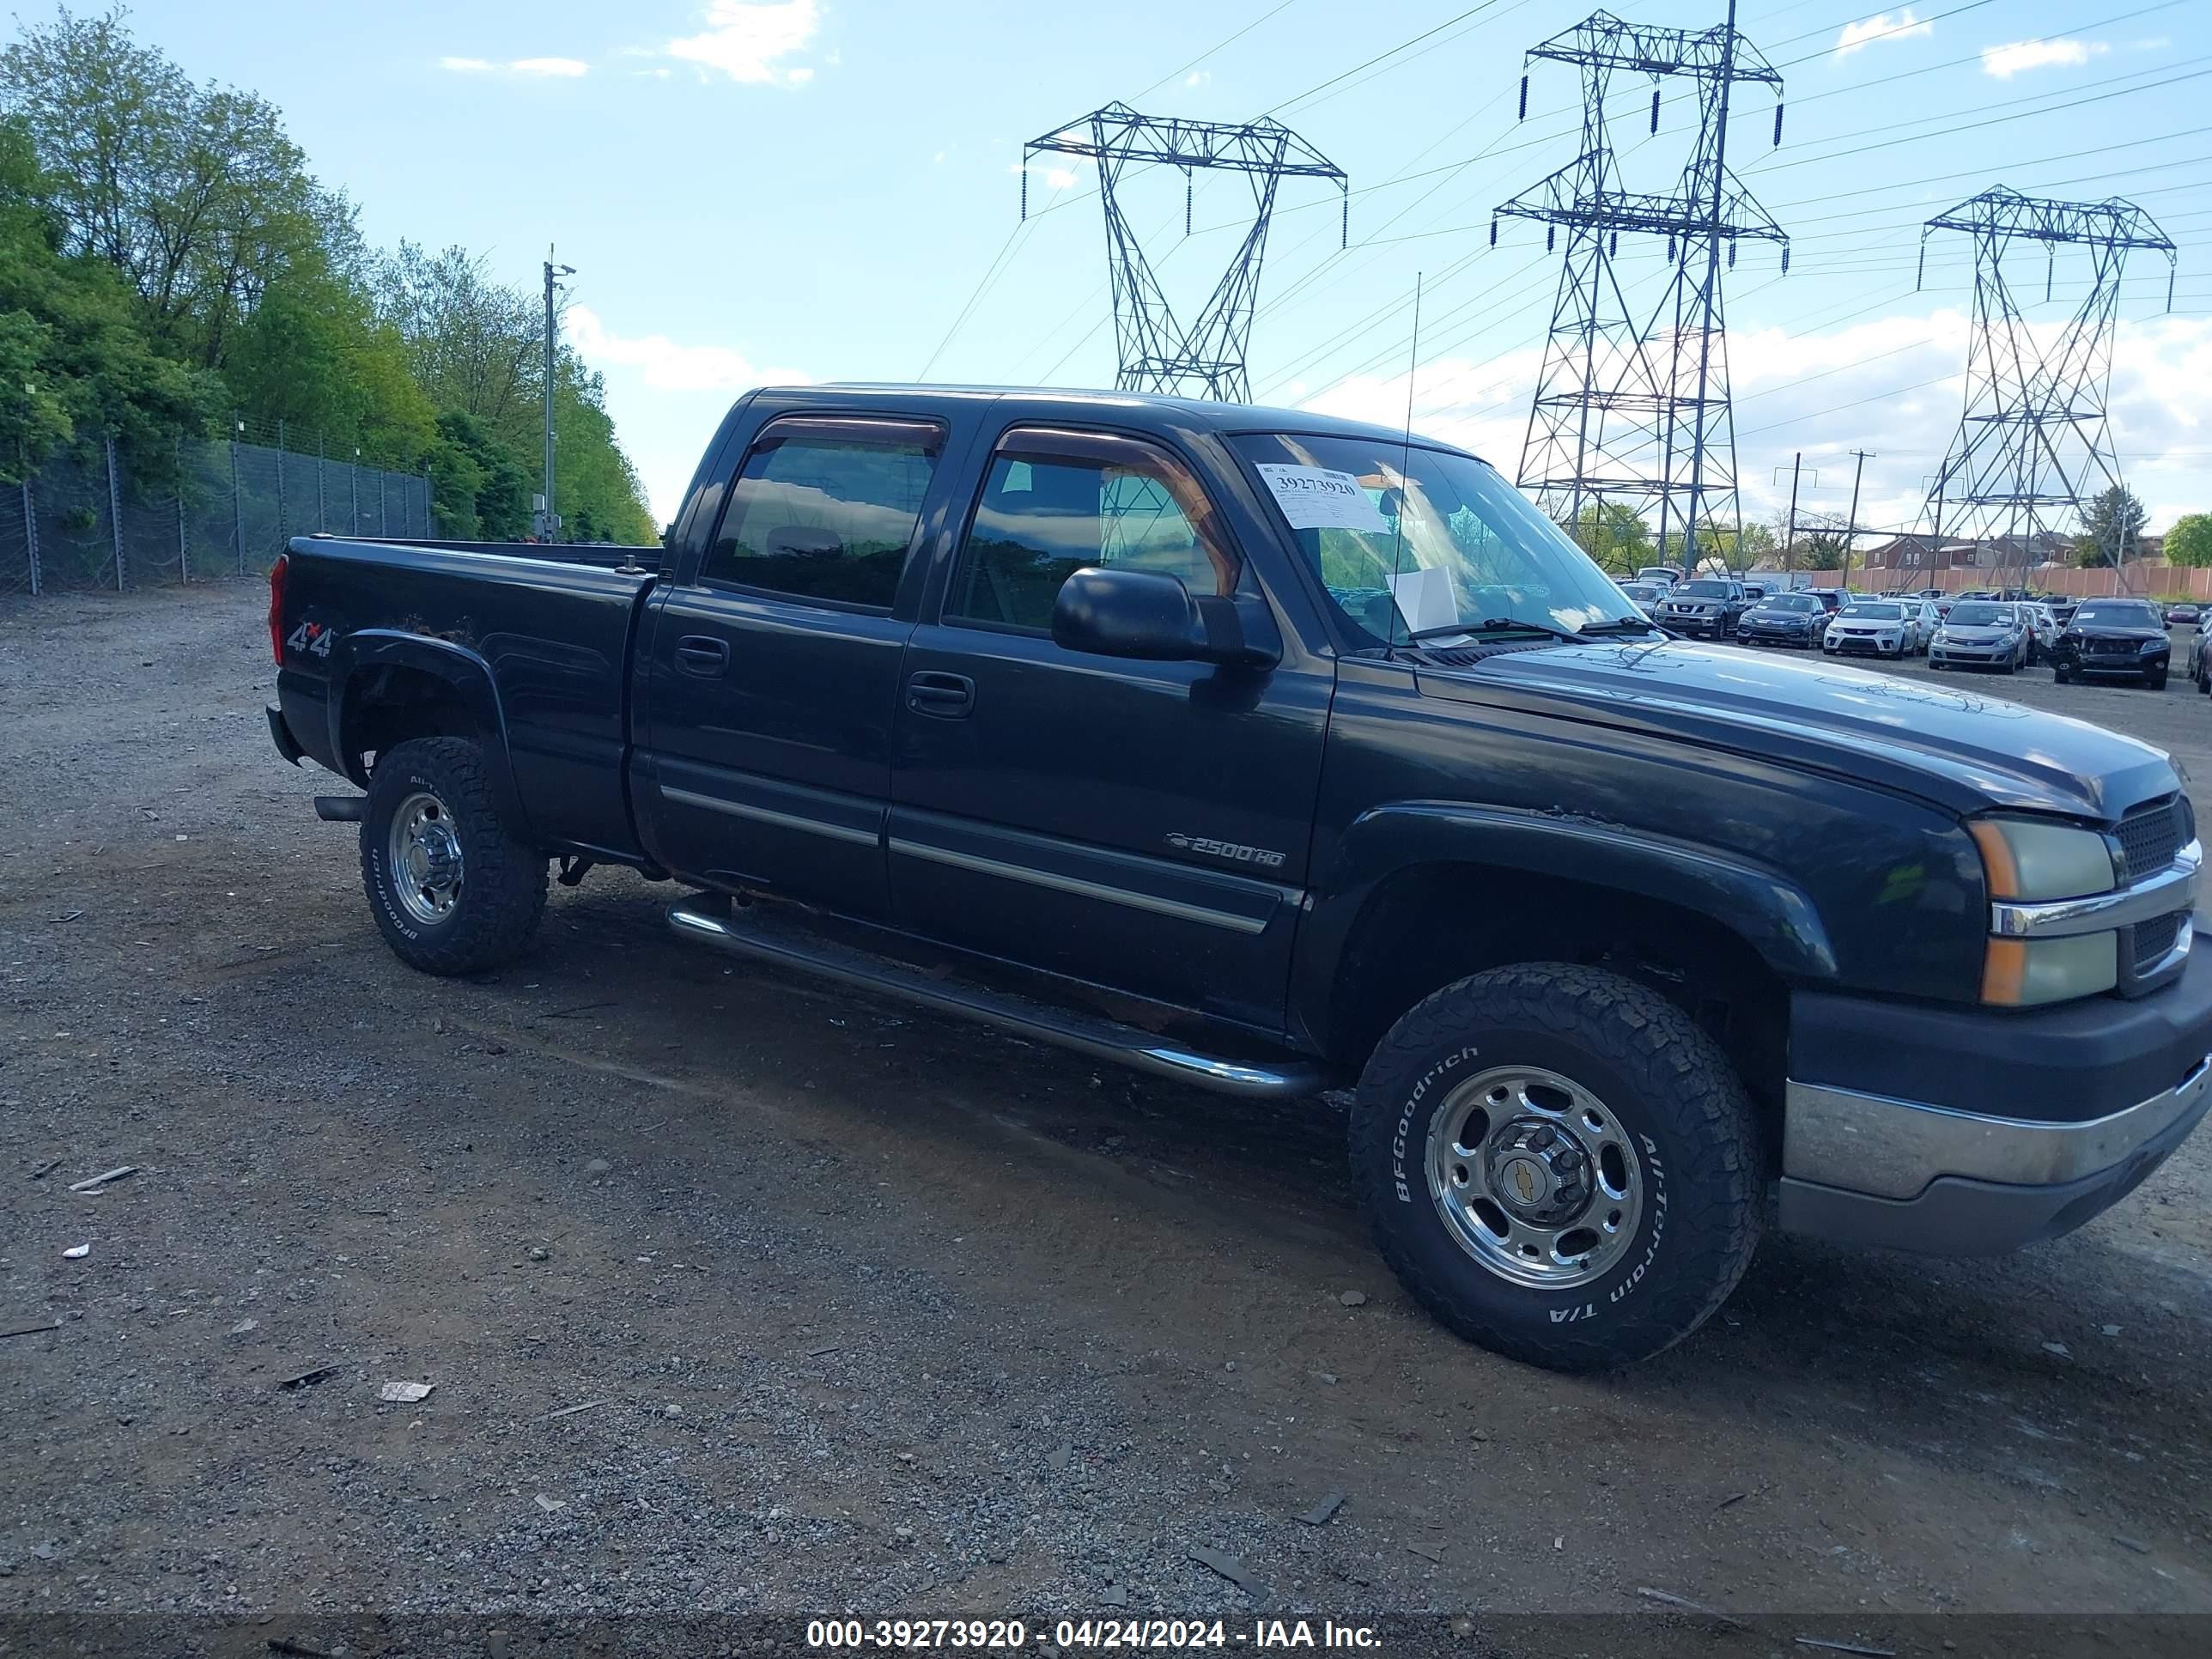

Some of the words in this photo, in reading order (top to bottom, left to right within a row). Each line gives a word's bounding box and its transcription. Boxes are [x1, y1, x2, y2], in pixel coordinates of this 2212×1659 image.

[1276, 477, 1356, 496] 39273920
[1191, 837, 1254, 861] 2500
[1255, 848, 1286, 867] HD
[371, 847, 419, 940] BFGoodrich
[1393, 1046, 1480, 1203] BFGoodrich
[1609, 1133, 1668, 1303] All-Terrain
[1548, 1303, 1600, 1324] T/A
